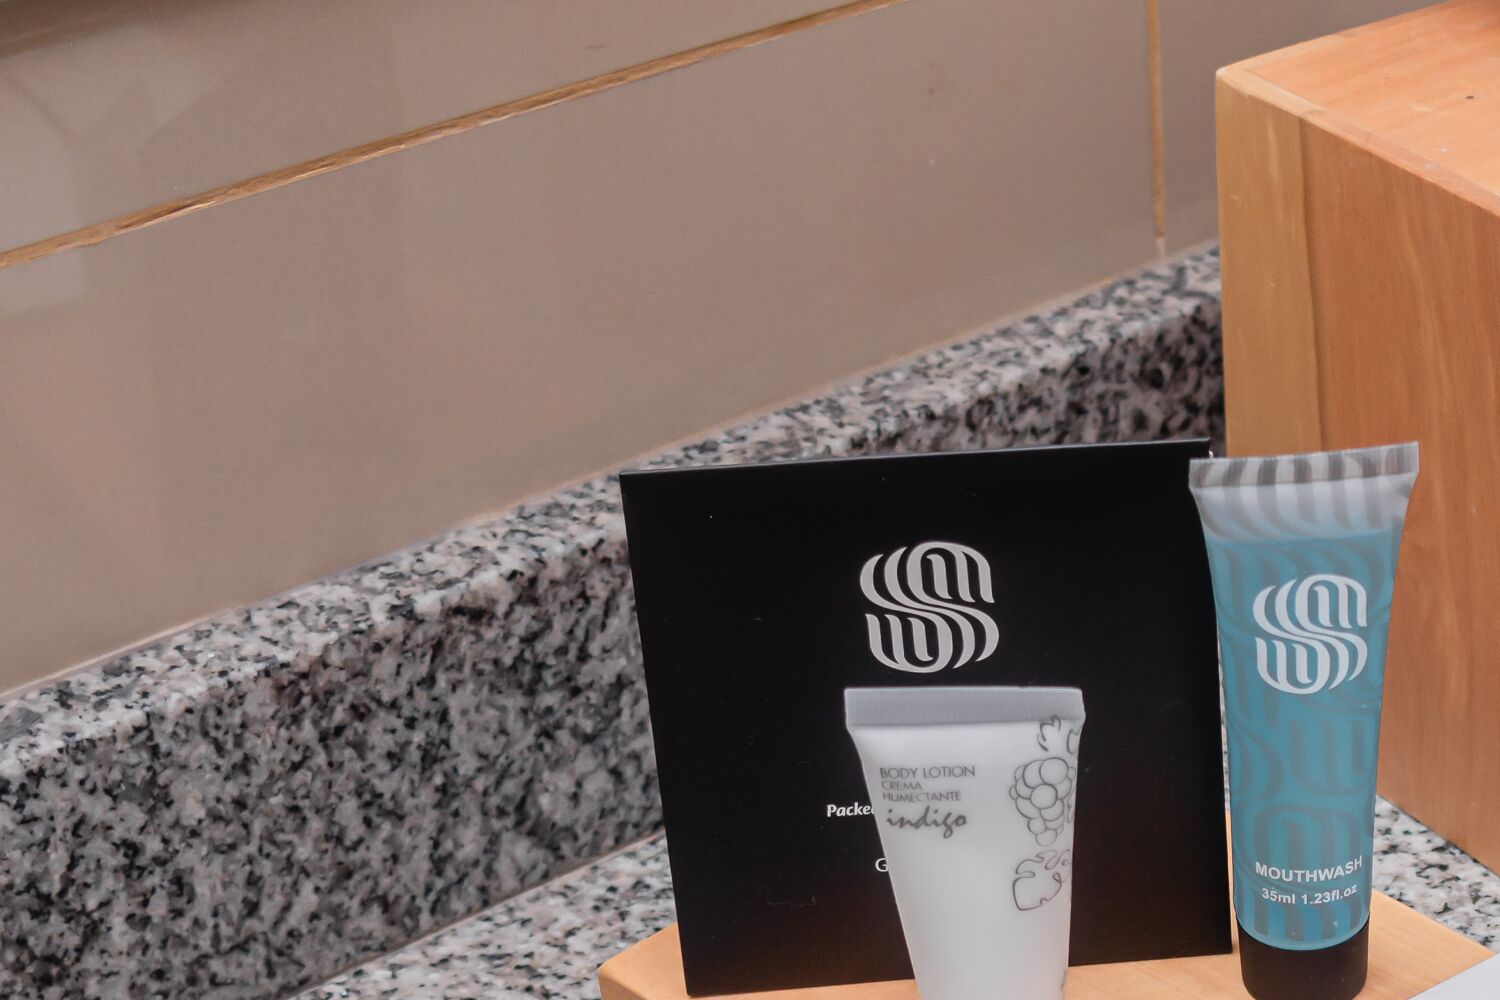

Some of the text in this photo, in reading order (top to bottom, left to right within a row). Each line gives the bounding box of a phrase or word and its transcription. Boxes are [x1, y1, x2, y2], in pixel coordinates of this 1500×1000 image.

[880, 765, 976, 779] BODY LOTION
[881, 781, 922, 791] CREMA
[883, 791, 963, 803] HUMECTANTE
[886, 805, 967, 839] indigo
[1255, 855, 1363, 883] MOUTHWASH
[1261, 884, 1358, 905] 35ml 1.23fl.oz
